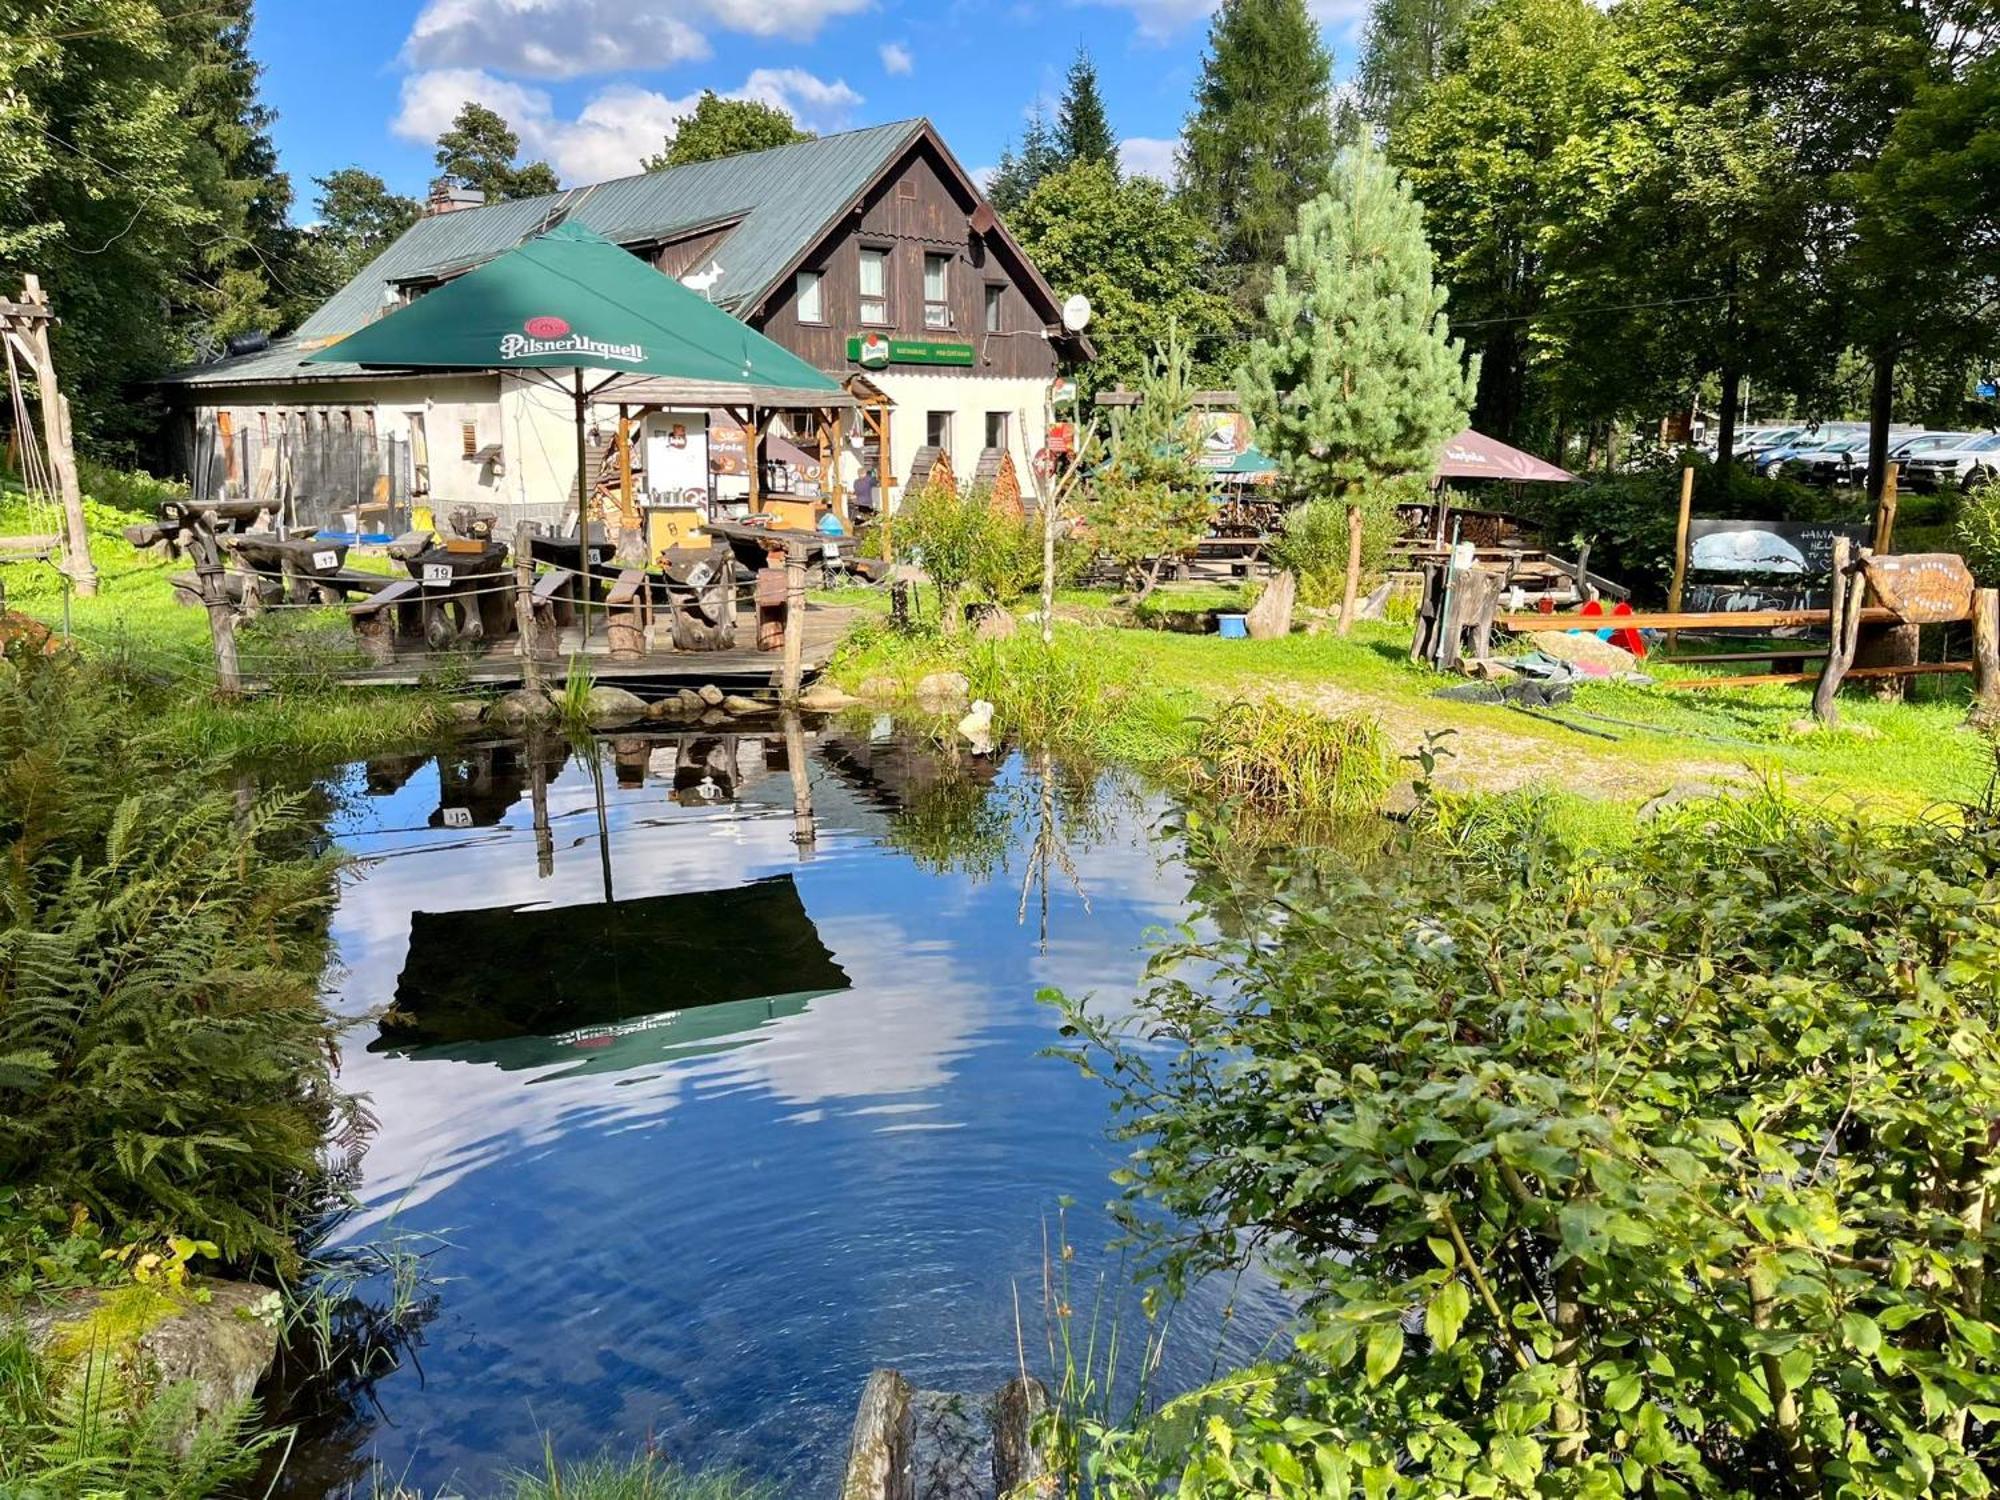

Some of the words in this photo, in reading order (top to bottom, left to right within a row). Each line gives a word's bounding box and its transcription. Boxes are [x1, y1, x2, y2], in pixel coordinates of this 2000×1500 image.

[500, 333, 575, 359] Pilsner
[572, 334, 642, 360] Urquell
[433, 567, 449, 578] 19
